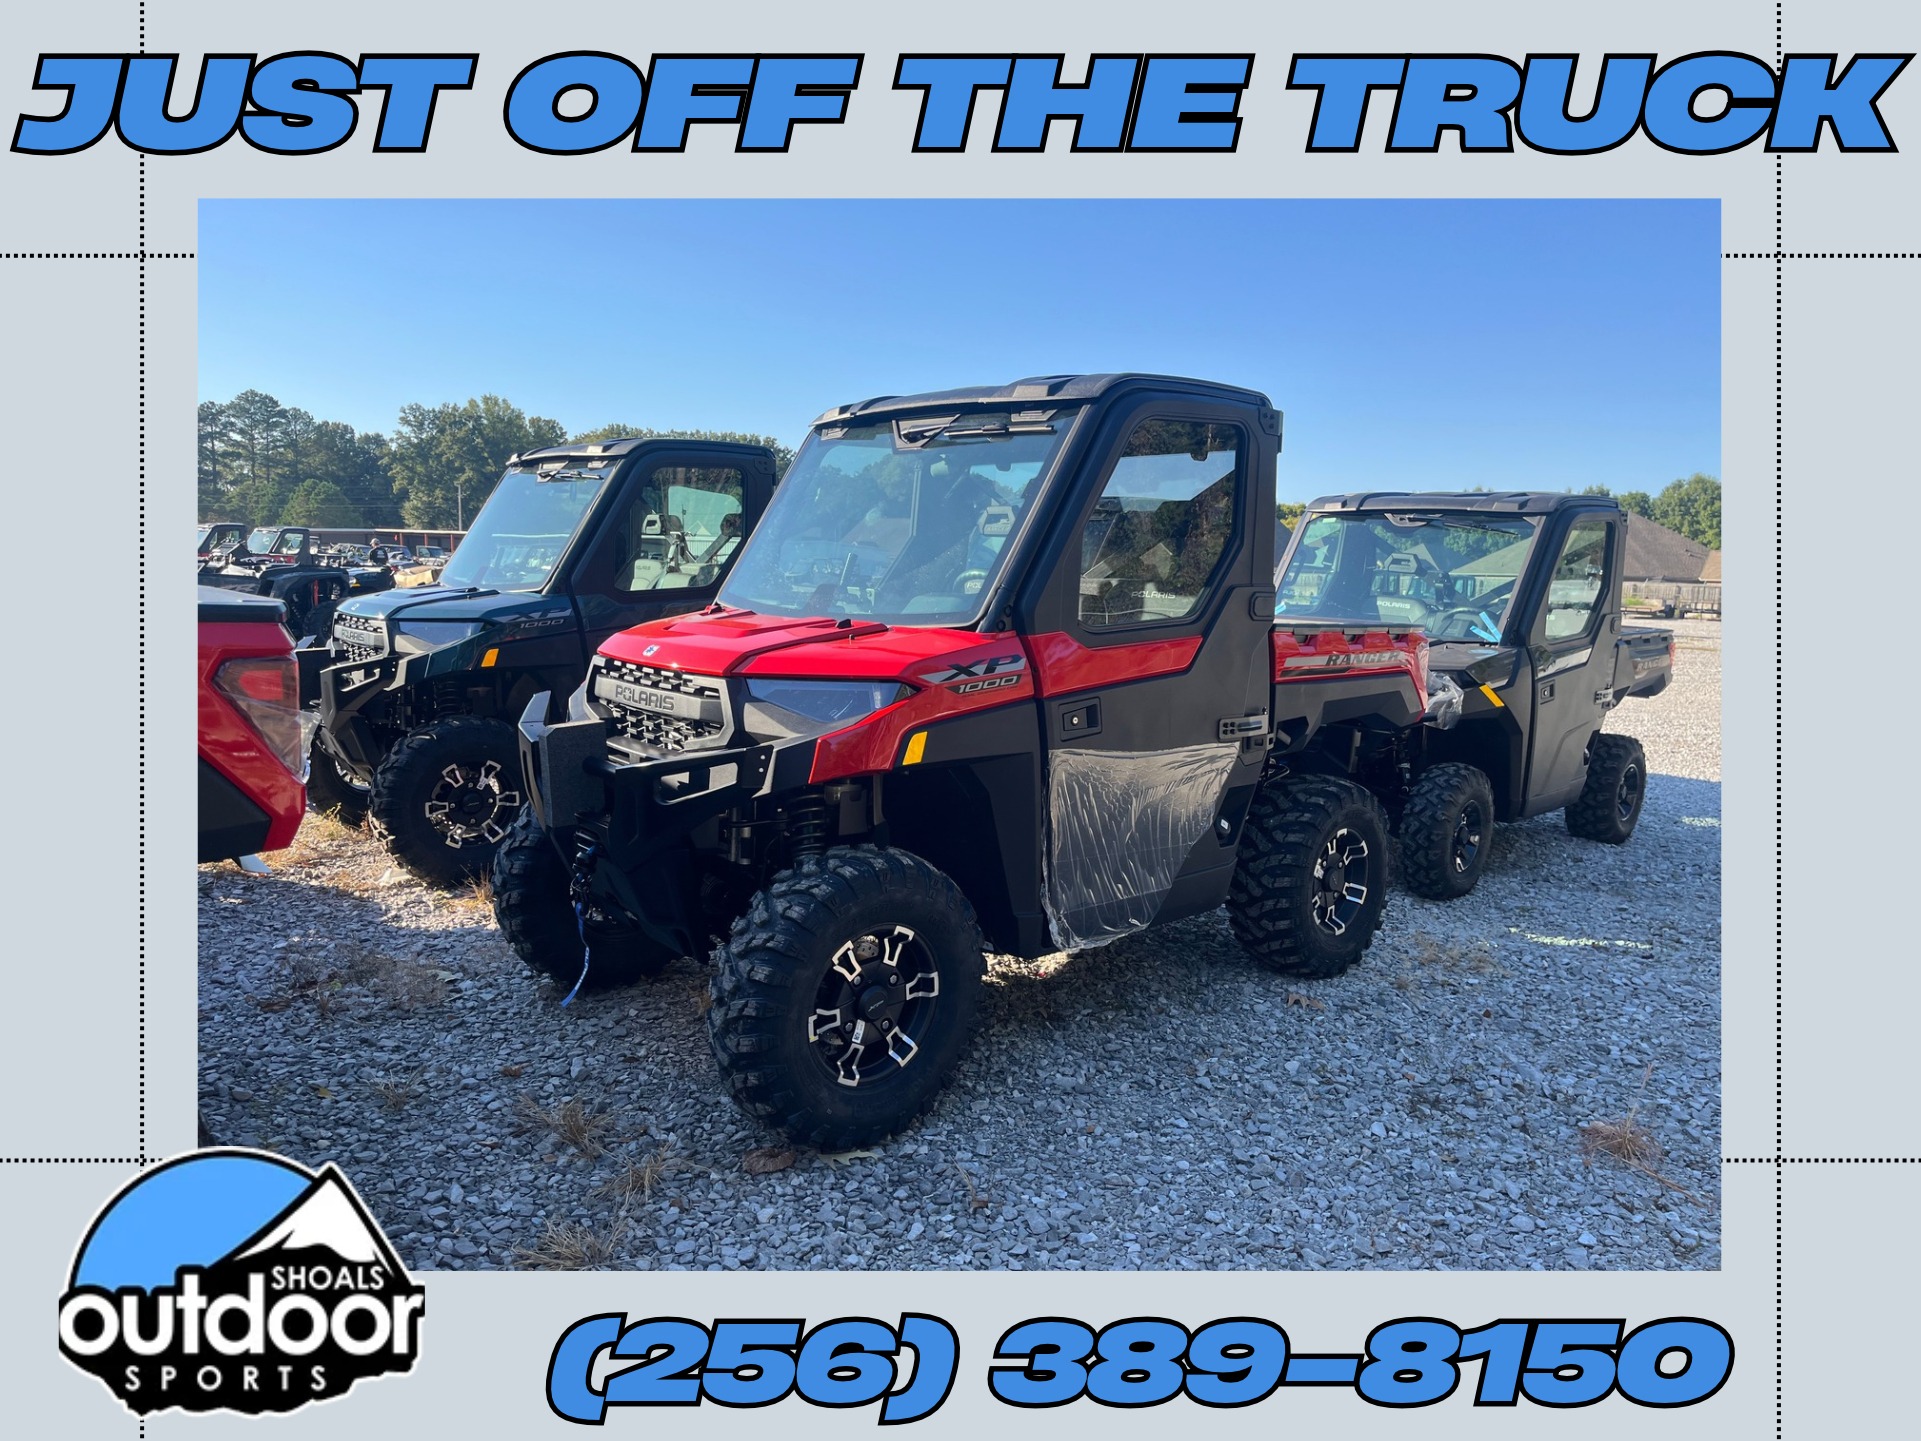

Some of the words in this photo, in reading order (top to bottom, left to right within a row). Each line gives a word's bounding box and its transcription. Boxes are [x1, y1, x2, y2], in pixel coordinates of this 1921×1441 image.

[1131, 590, 1176, 599] POLARIS
[1376, 600, 1411, 609] POLARIS
[520, 619, 565, 629] 1000
[1325, 651, 1401, 667] RANGER
[940, 653, 1023, 683] XP
[958, 675, 1018, 694] 1000
[616, 684, 675, 711] POLARIS
